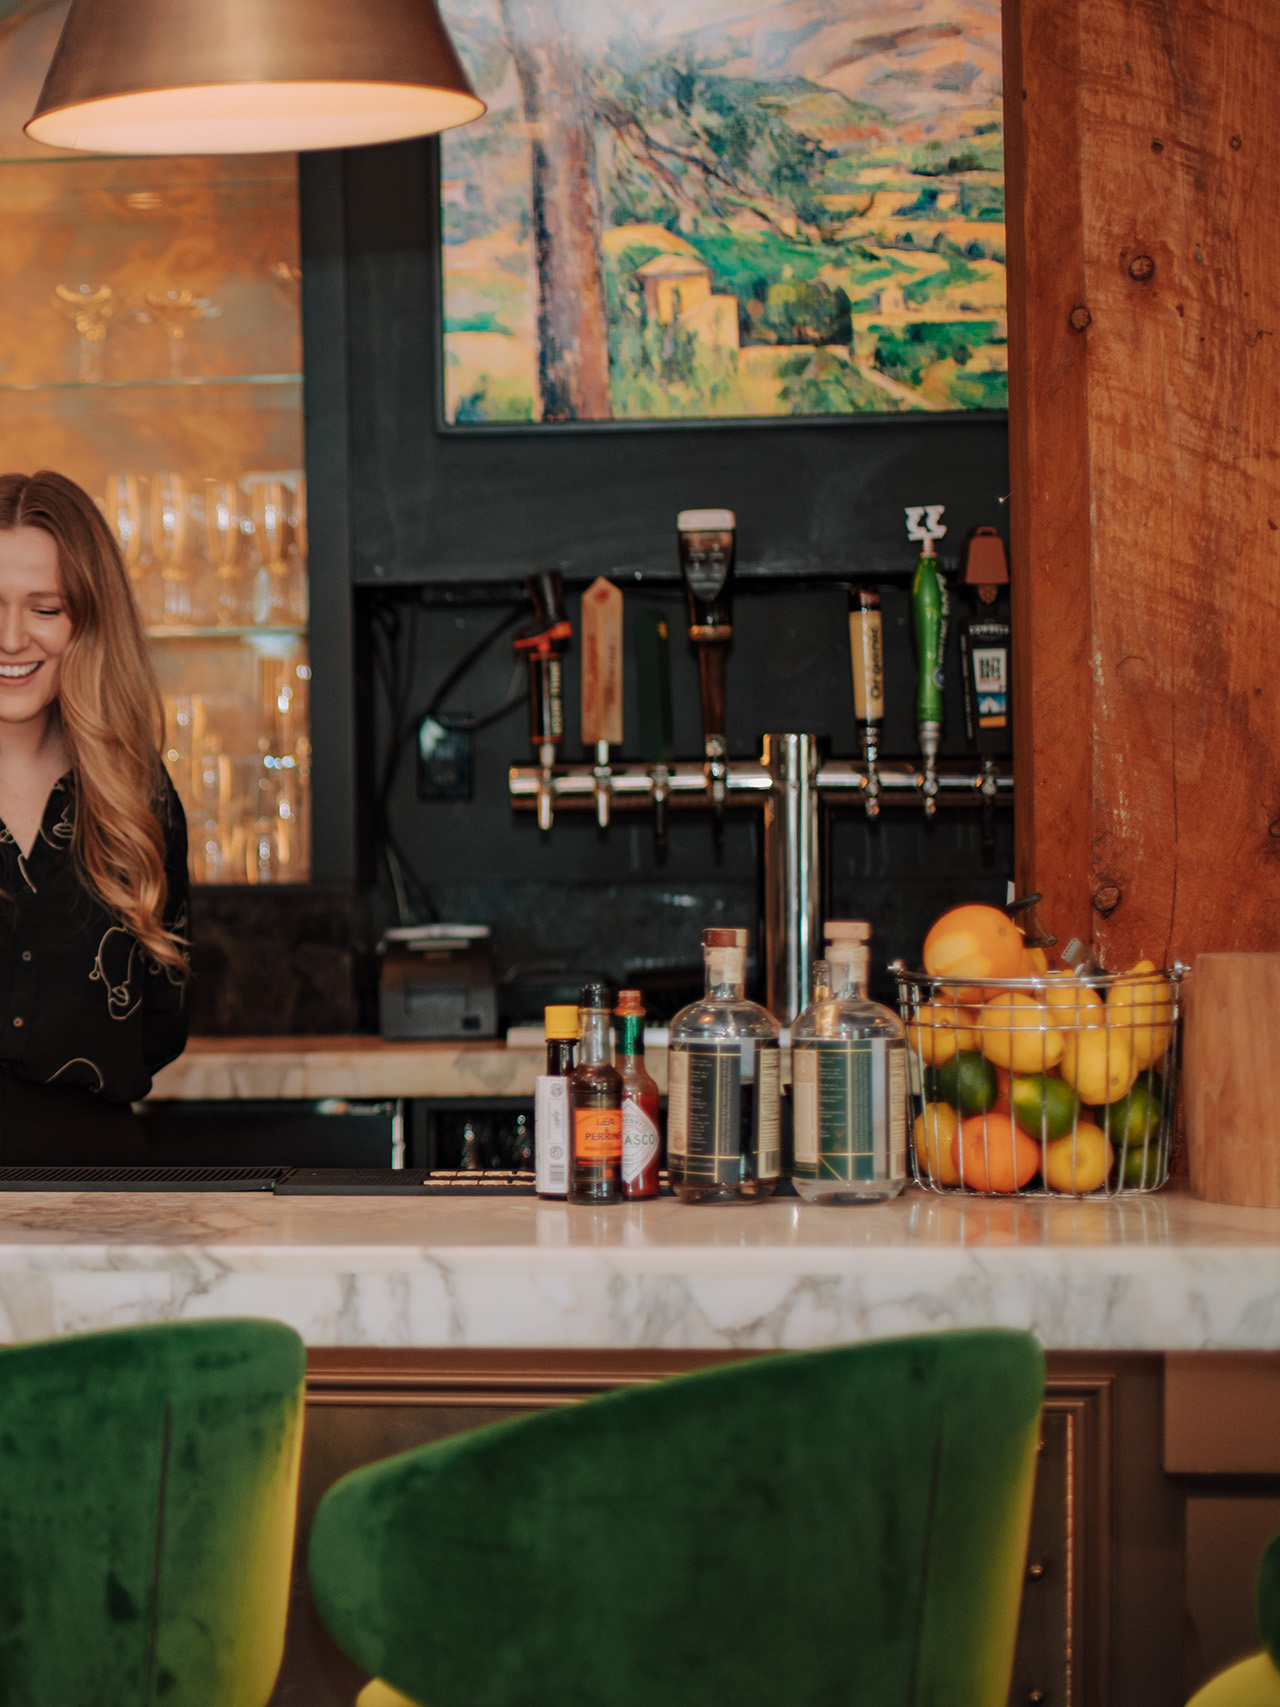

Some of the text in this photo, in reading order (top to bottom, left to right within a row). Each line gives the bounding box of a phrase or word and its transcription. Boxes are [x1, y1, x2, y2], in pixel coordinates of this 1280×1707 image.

[870, 625, 883, 699] Organic
[596, 1117, 615, 1126] LEA
[585, 1132, 622, 1141] PERRINS
[623, 1133, 655, 1146] ASCO
